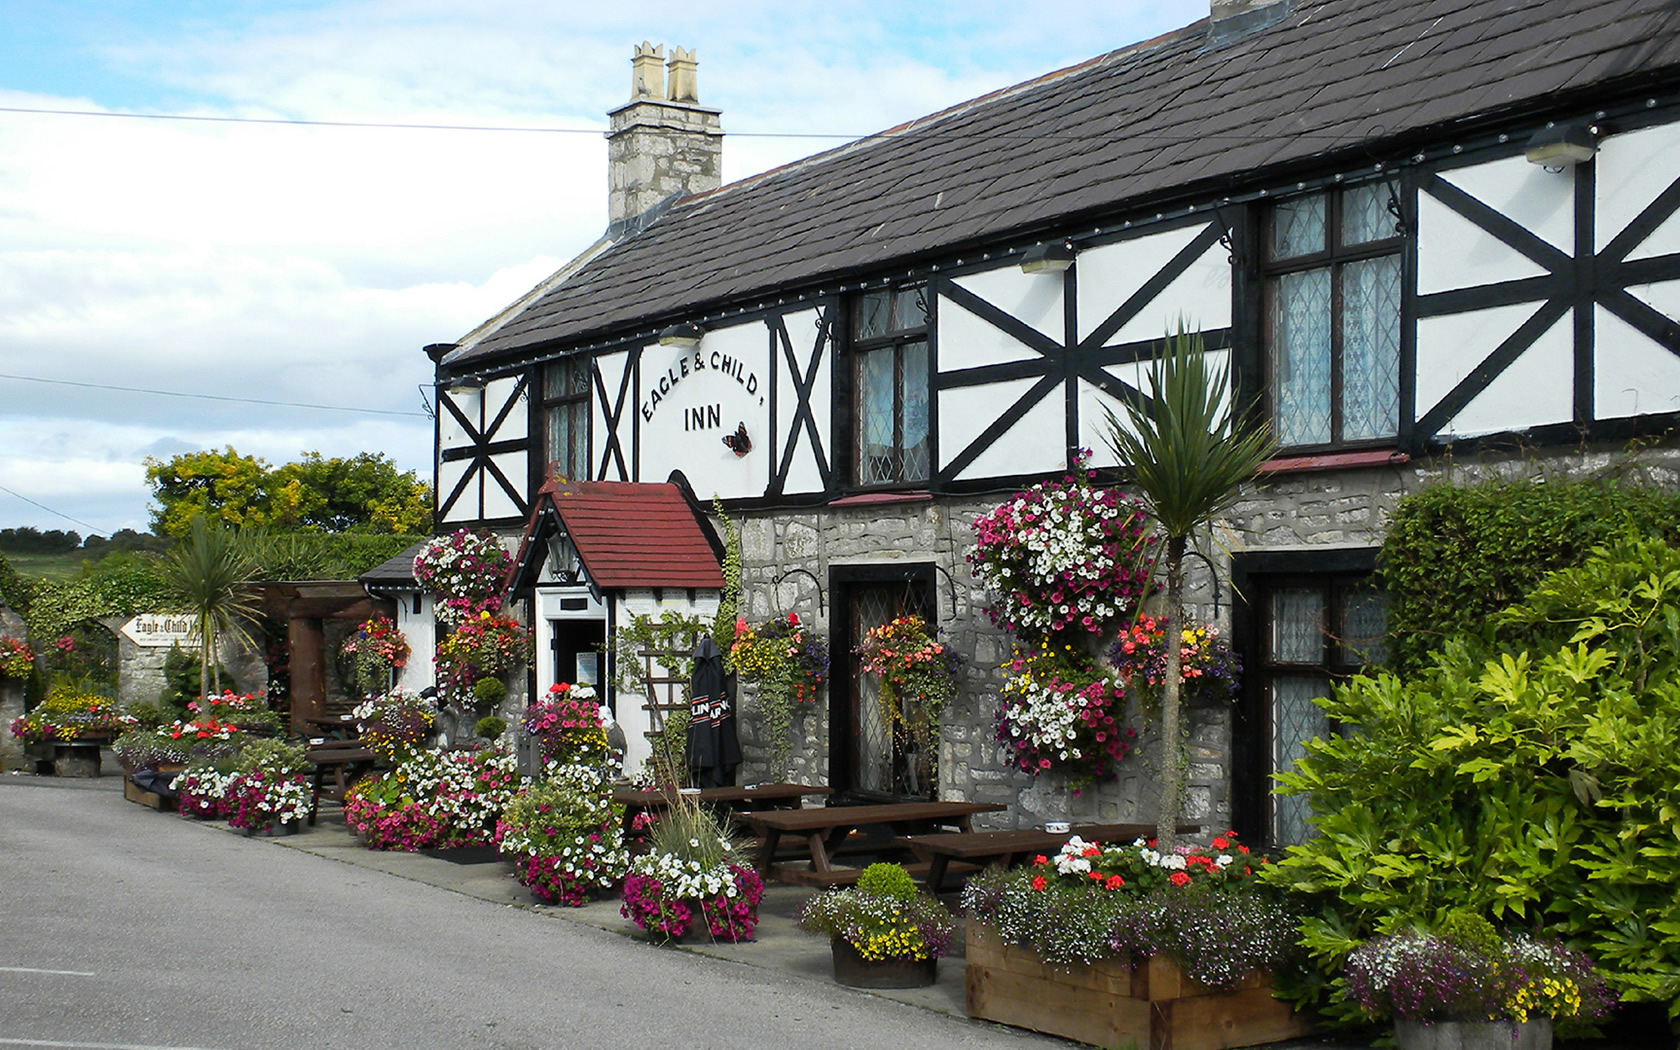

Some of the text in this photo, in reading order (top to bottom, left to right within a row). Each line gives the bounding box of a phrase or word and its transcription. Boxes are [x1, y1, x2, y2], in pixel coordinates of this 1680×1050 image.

[641, 357, 690, 423] EAGLE
[694, 352, 706, 372] &
[684, 403, 721, 432] INN
[135, 618, 159, 635] Eagle
[165, 619, 188, 633] Child
